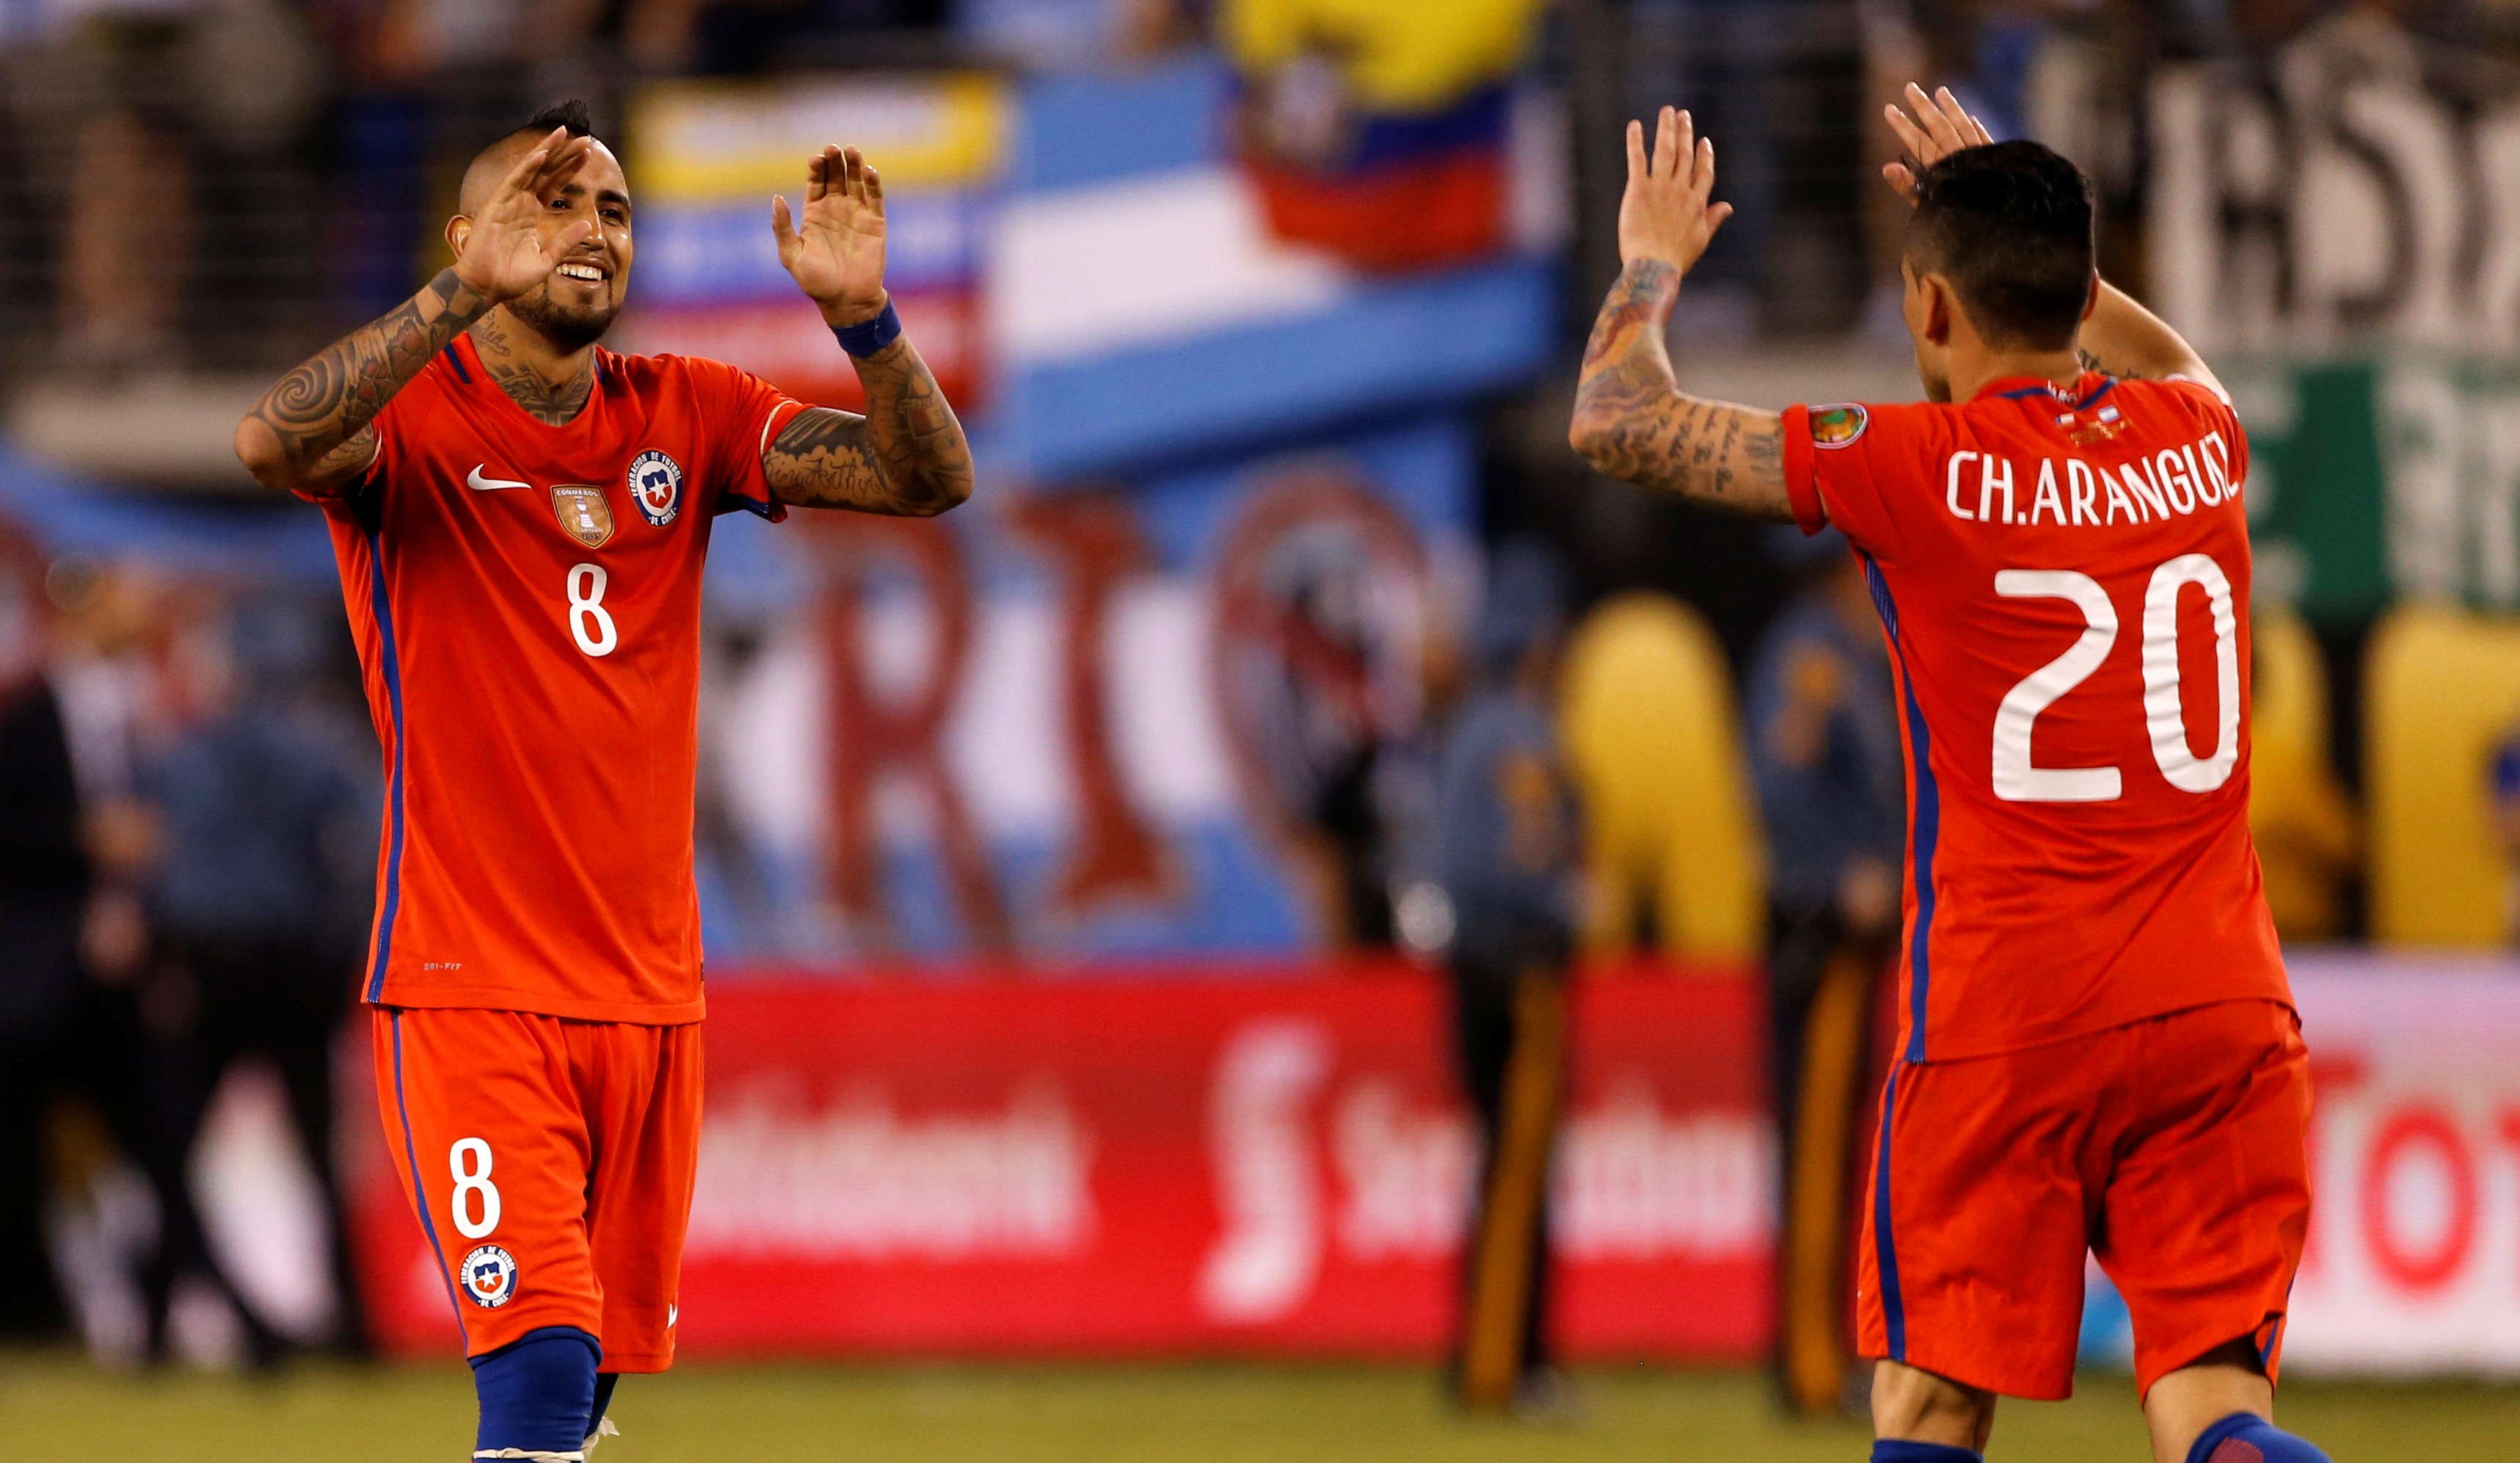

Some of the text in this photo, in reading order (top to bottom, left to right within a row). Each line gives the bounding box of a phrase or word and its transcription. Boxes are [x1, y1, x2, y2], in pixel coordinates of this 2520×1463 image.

[567, 563, 618, 657] 8
[1992, 553, 2240, 802] 20
[423, 962, 462, 971] DRI-FIT
[449, 1137, 501, 1239] 8
